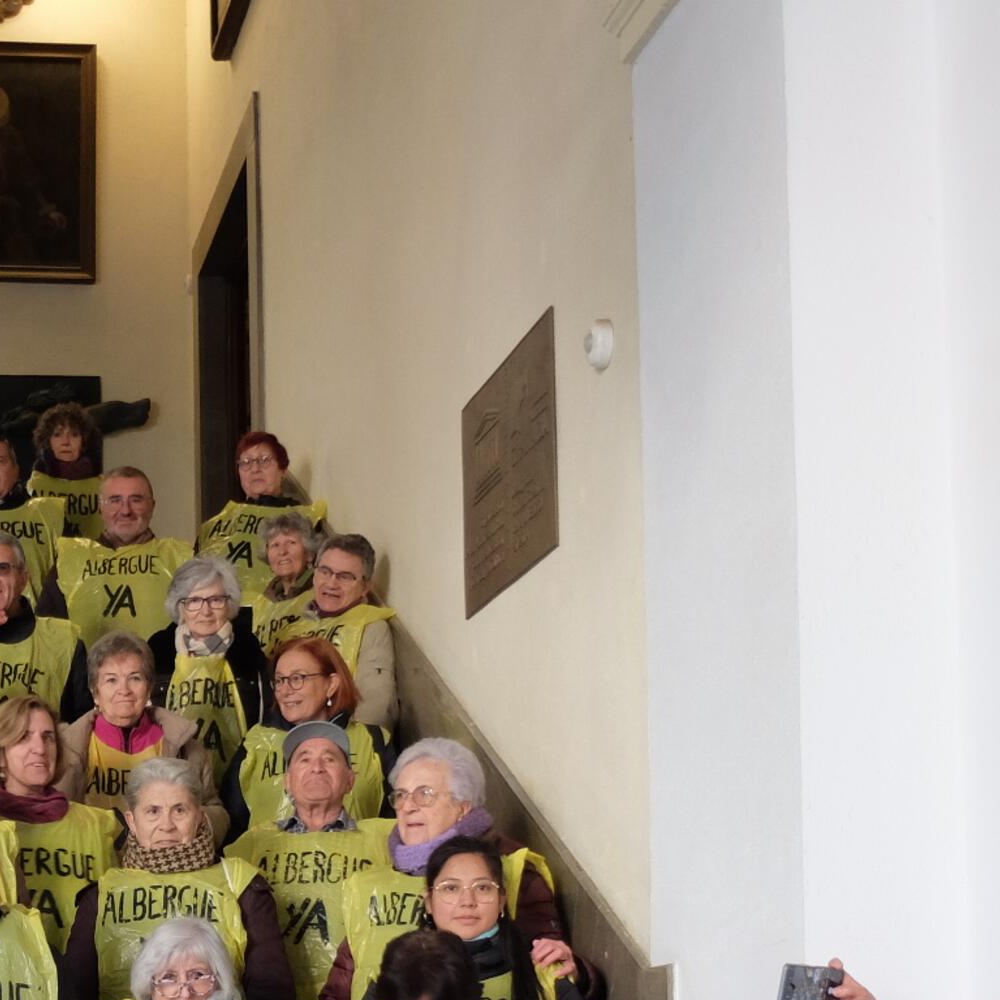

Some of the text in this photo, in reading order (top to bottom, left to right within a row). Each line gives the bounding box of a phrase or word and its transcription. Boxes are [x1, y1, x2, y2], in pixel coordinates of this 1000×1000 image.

[82, 554, 160, 580] ALBERGUE
[226, 540, 253, 568] YA
[103, 584, 136, 617] YA
[101, 885, 221, 927] ALBERGUE
[283, 897, 330, 945] YA
